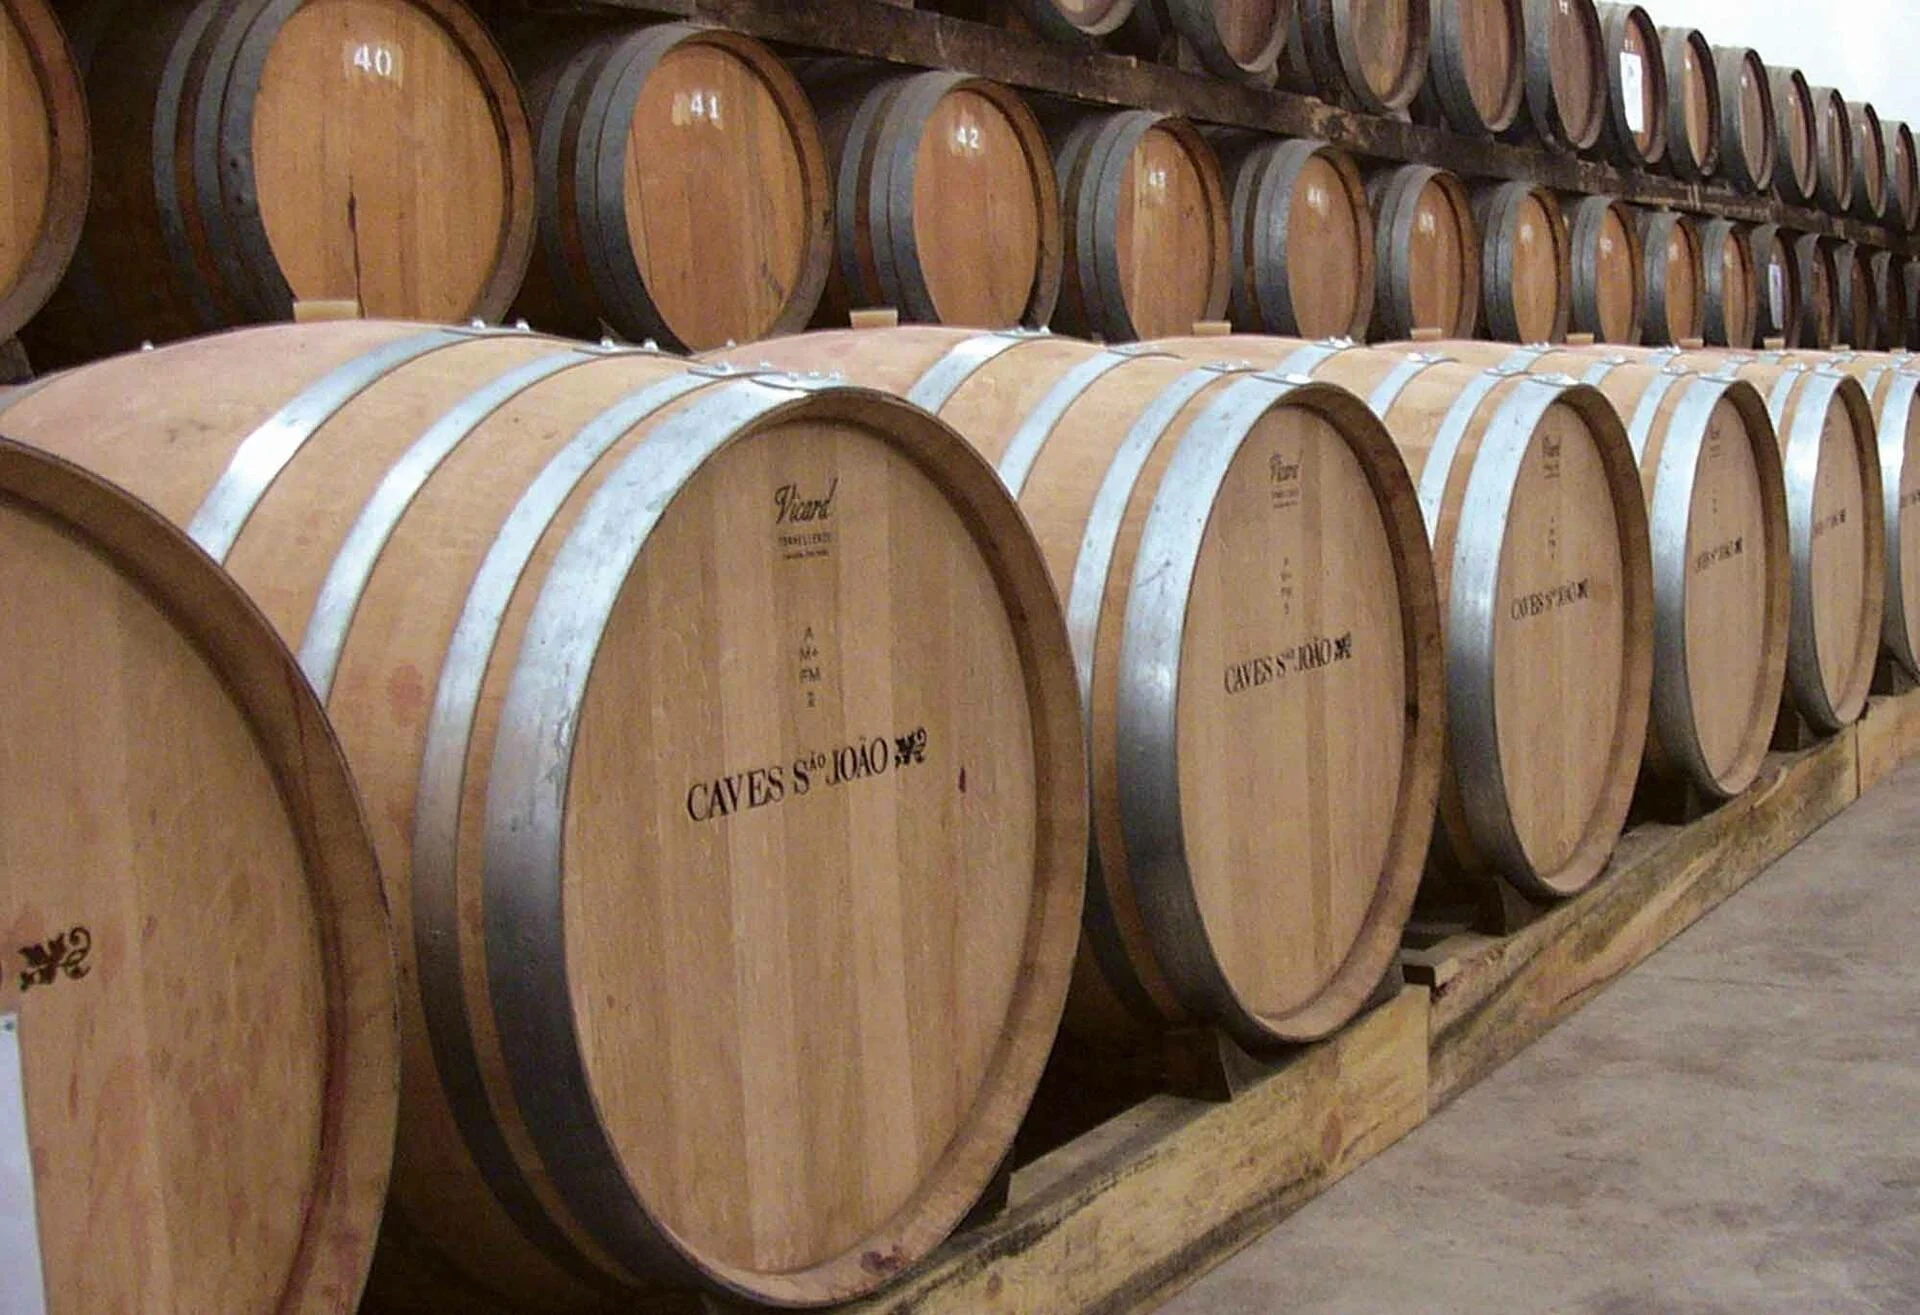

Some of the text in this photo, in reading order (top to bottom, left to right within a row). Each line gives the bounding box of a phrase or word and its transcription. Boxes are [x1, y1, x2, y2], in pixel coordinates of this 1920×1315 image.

[353, 43, 392, 77] 40
[691, 92, 719, 120] 41
[956, 126, 979, 149] 42
[774, 476, 839, 525] Vicard
[1223, 656, 1273, 695] CAVES
[686, 766, 786, 823] CAVES
[825, 735, 889, 787] JOÃO
